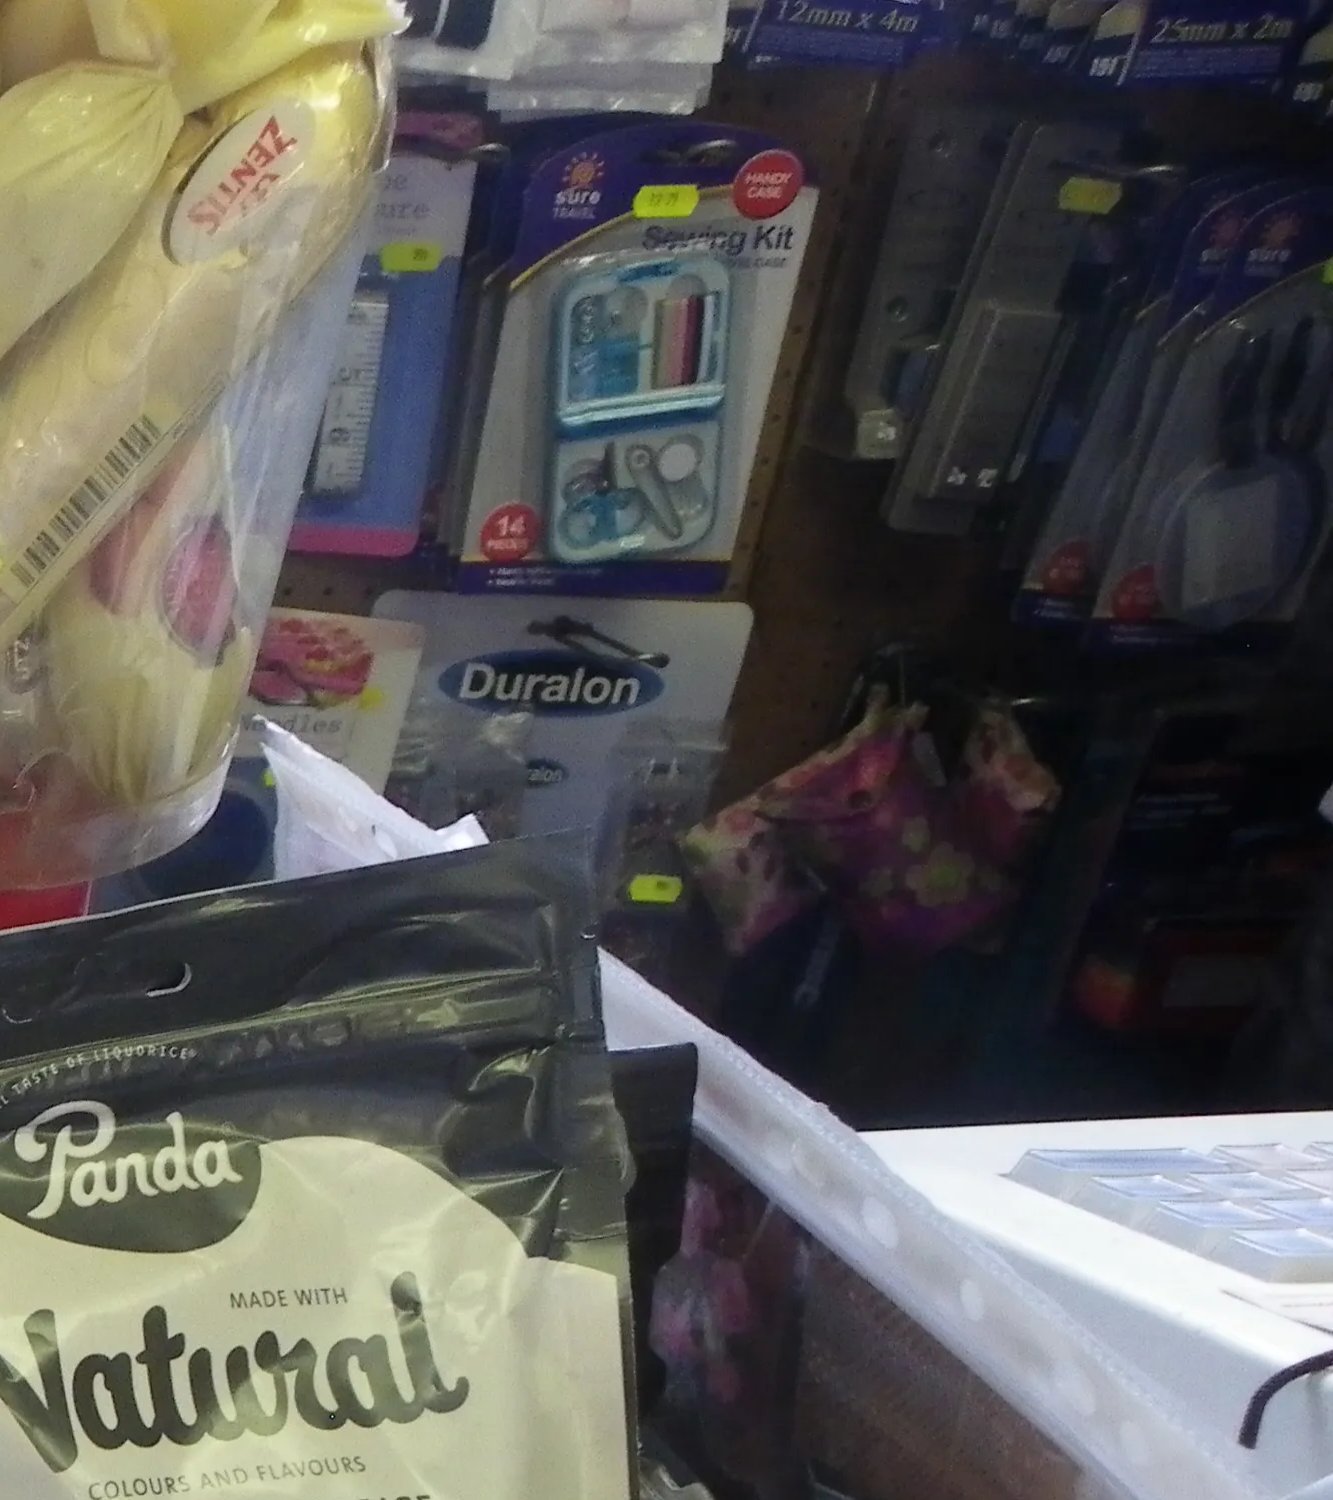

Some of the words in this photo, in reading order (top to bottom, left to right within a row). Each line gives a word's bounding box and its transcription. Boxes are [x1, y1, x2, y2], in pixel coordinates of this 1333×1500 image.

[752, 224, 794, 251] Kit
[458, 661, 642, 707] Duralon
[14, 1099, 245, 1221] Panda
[229, 1287, 289, 1311] MADE
[293, 1284, 350, 1309] WITH
[199, 1465, 252, 1491] AND
[255, 1453, 368, 1483] FLAVOURS
